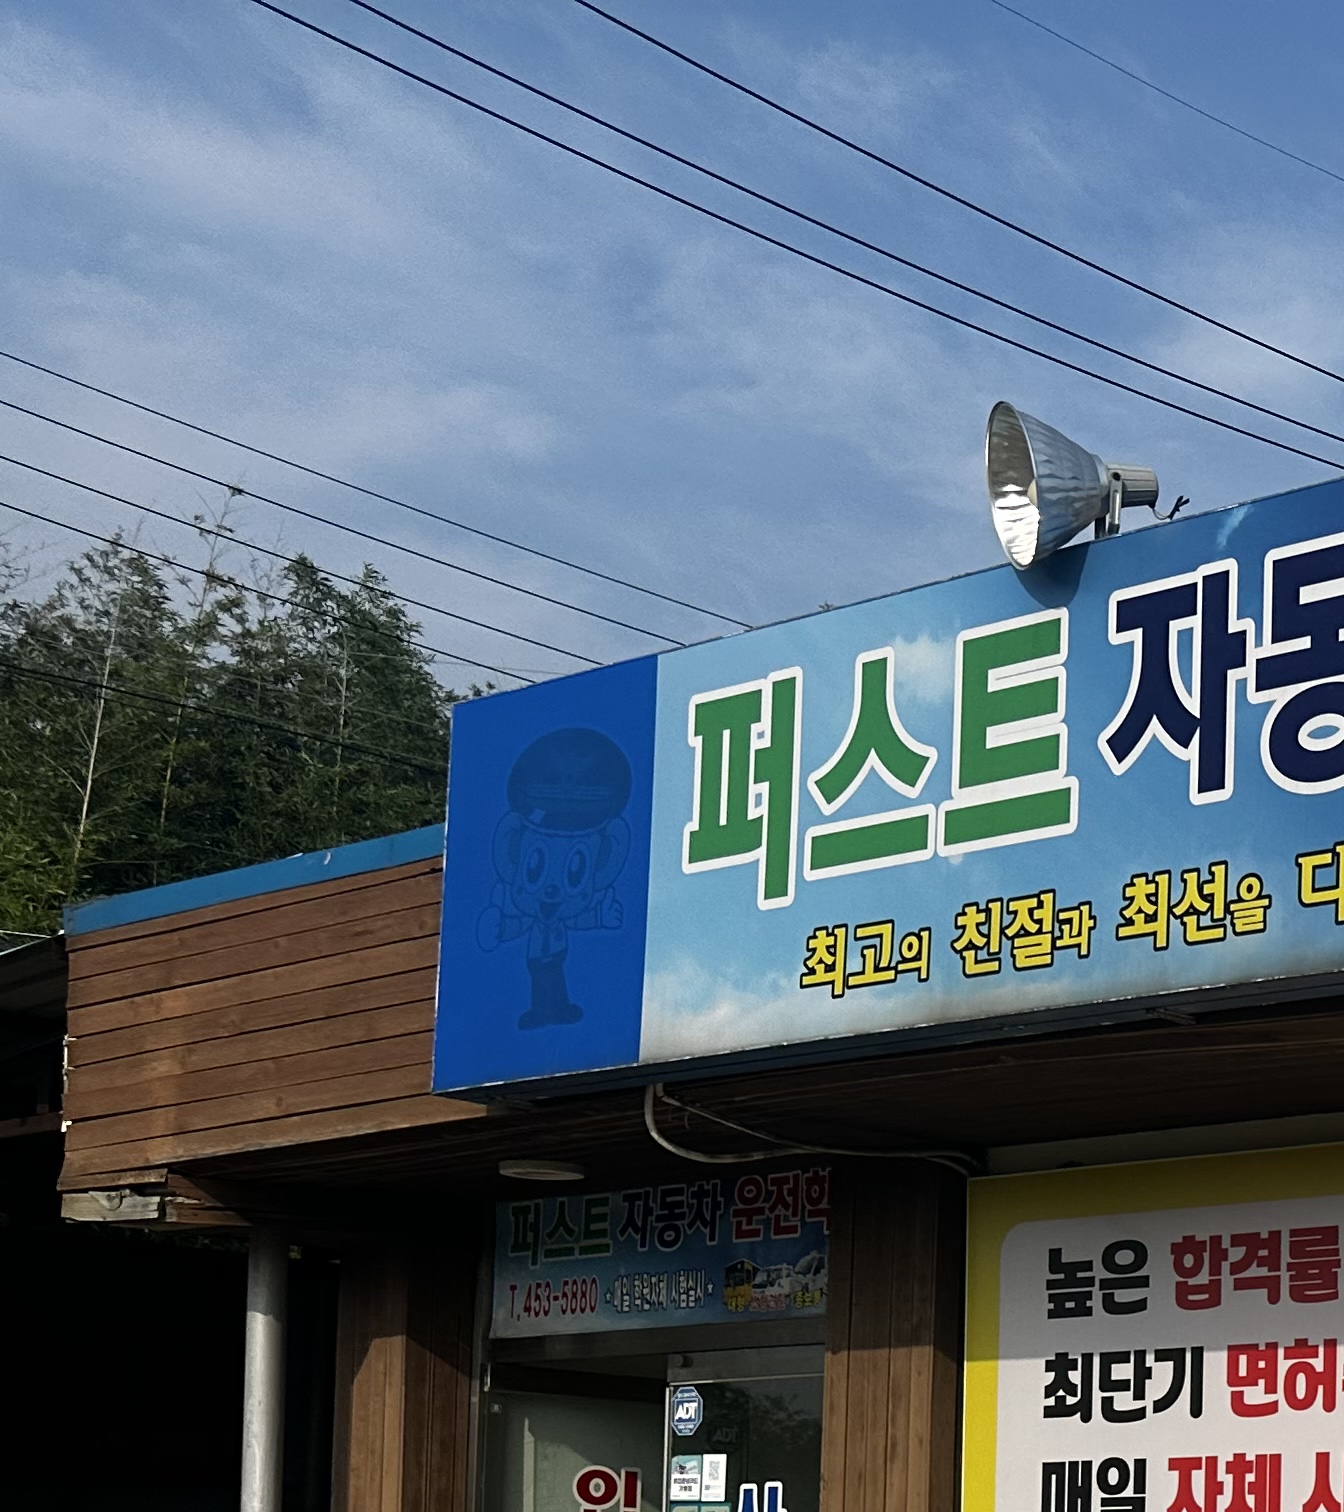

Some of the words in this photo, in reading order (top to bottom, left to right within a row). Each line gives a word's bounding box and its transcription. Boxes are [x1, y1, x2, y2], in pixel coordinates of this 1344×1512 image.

[681, 606, 1079, 909] 퍼스트
[800, 916, 931, 995] 최고의
[951, 889, 1095, 975] 친절과
[1115, 862, 1271, 948] 최선을
[509, 1193, 613, 1269] 퍼스트
[618, 1179, 723, 1251] 자동차
[1045, 1239, 1150, 1319] 높은
[675, 1402, 698, 1420] ADT
[1043, 1346, 1204, 1423] 최단기
